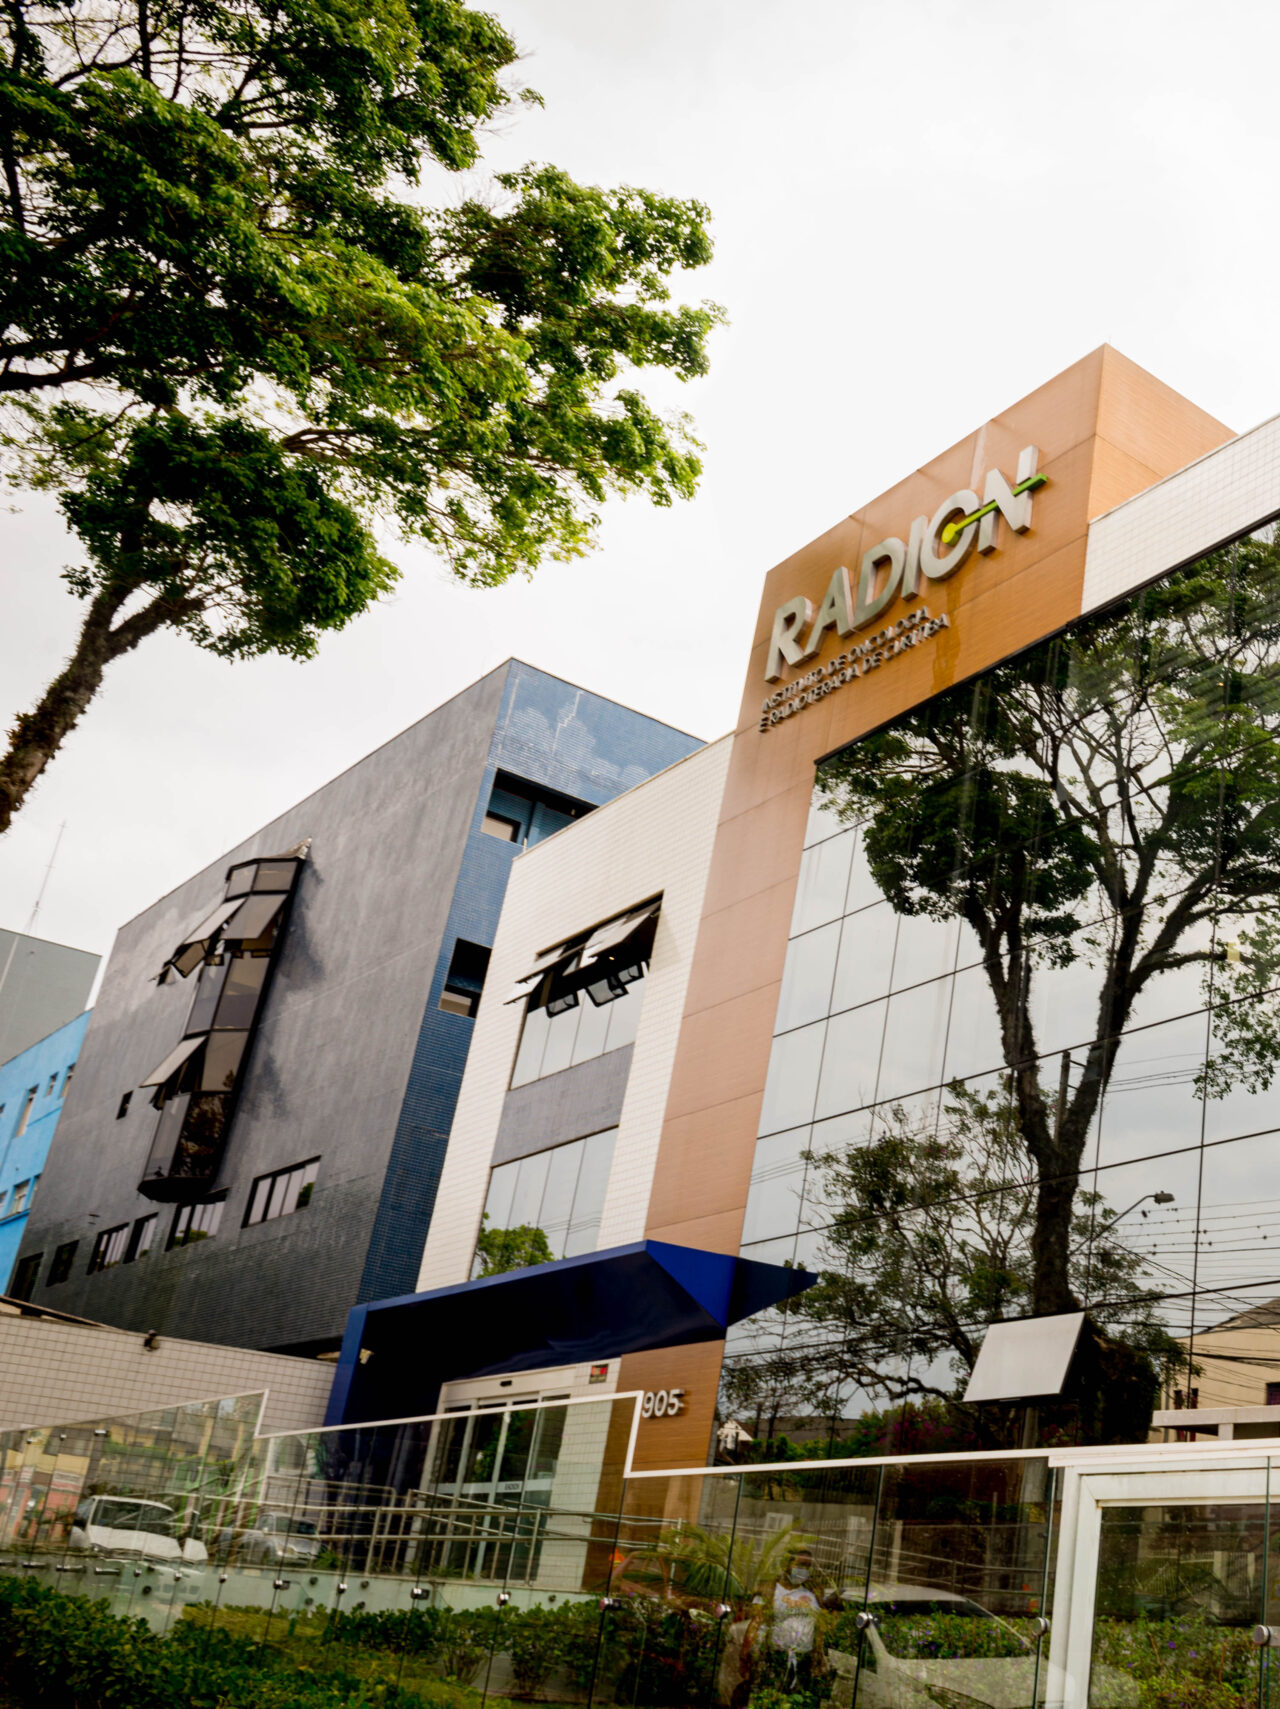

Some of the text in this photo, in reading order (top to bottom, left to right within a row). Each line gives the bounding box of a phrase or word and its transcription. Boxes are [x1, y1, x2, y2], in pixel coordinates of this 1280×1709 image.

[765, 445, 1043, 683] RADION
[758, 612, 949, 733] E RADIOTERAPIA DE CURITIBA
[762, 605, 930, 713] INSTITUTO DE ONCOLOGIA
[641, 1387, 684, 1418] 905
